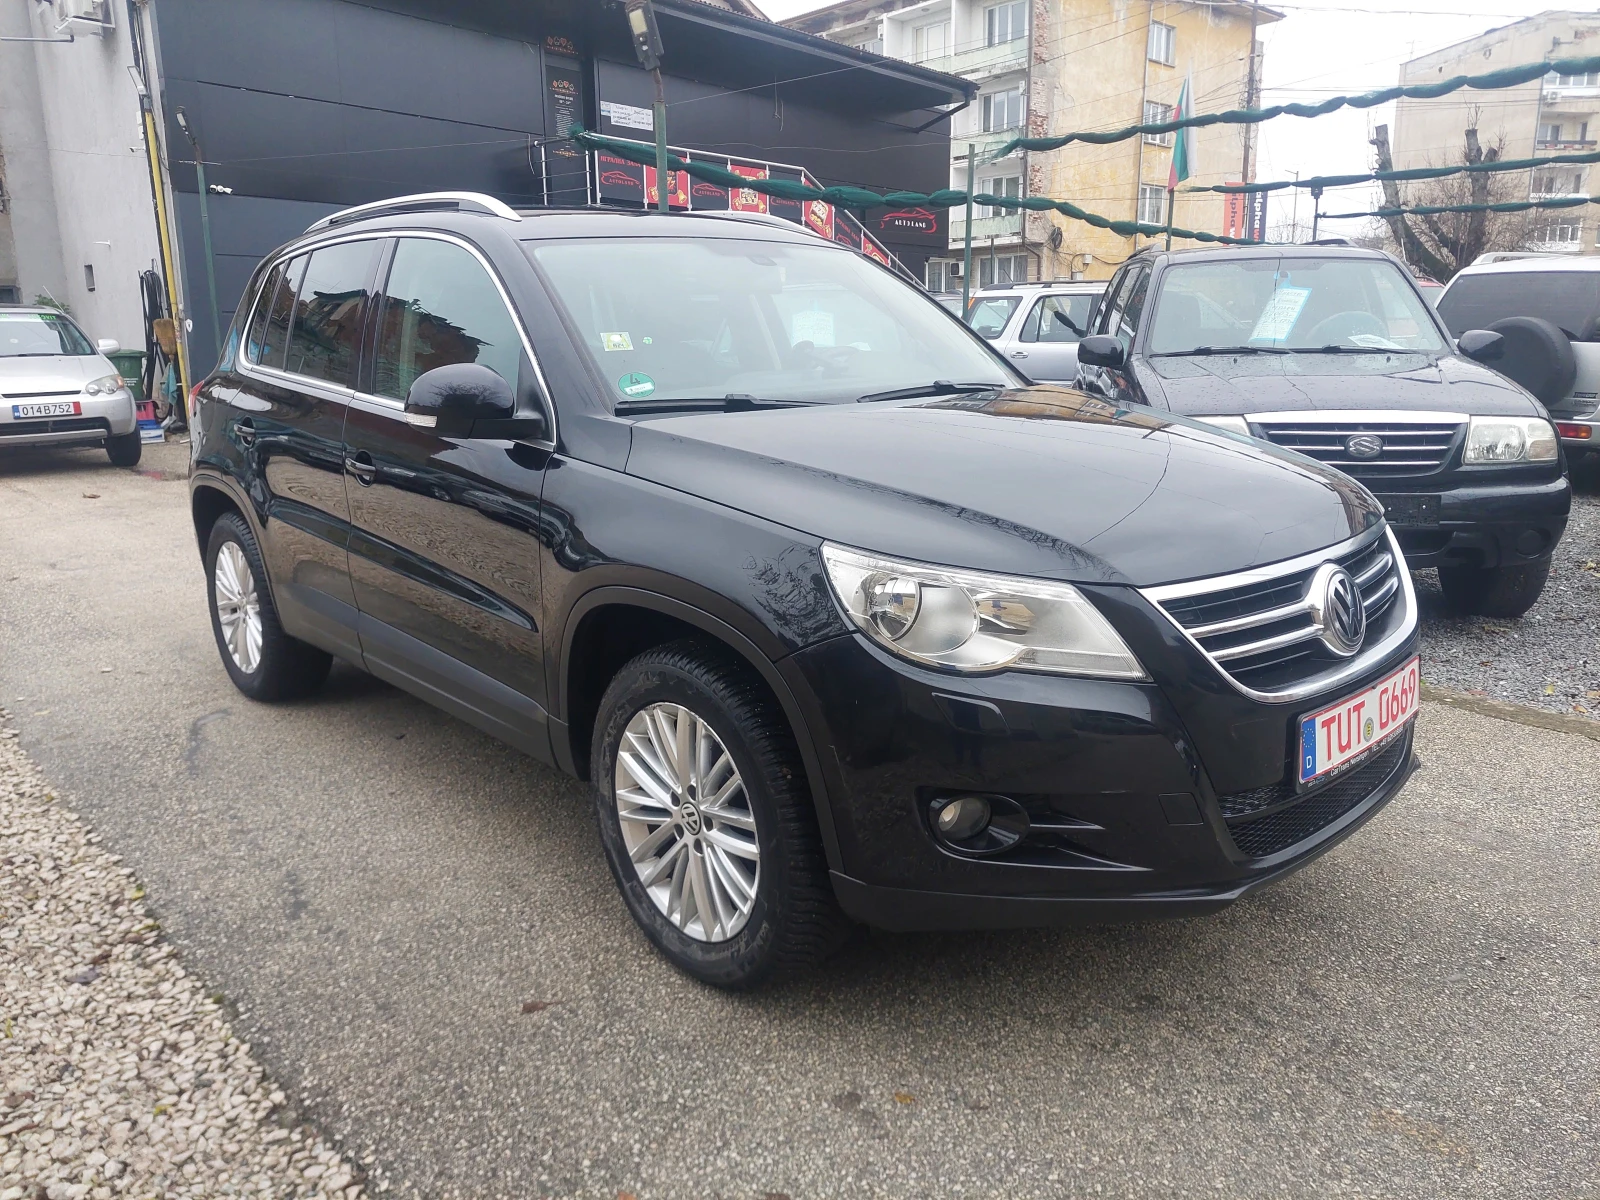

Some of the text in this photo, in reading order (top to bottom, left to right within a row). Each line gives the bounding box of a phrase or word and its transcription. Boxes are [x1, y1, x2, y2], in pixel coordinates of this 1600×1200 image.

[894, 219, 927, 228] AUTOLAND
[22, 403, 72, 416] 014B752
[1321, 668, 1416, 762] TUT 0669
[1306, 755, 1313, 769] D
